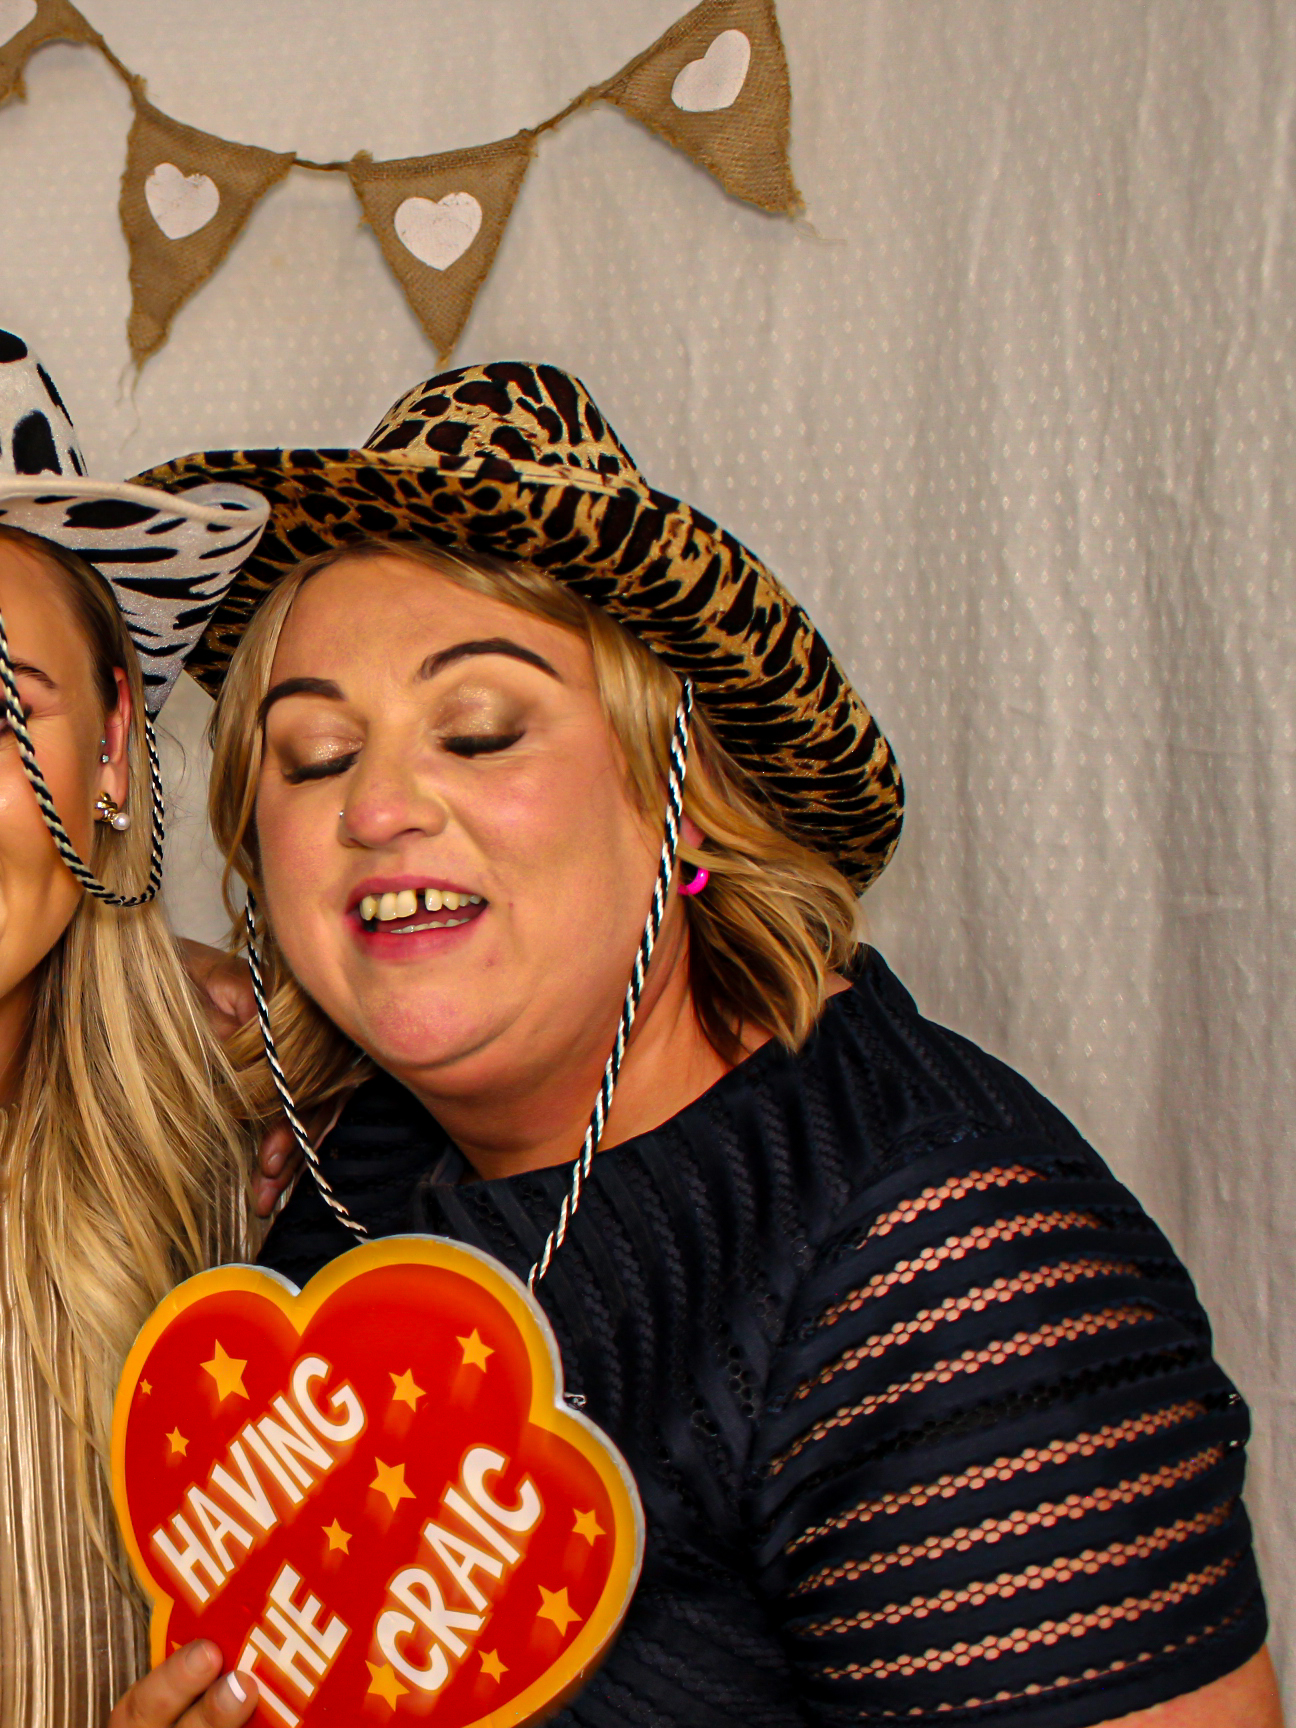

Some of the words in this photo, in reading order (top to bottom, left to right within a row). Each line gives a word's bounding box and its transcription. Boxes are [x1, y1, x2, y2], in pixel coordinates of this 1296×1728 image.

[152, 1356, 365, 1603] HAVING
[376, 1447, 542, 1691] CRAIC
[236, 1563, 349, 1728] THE
